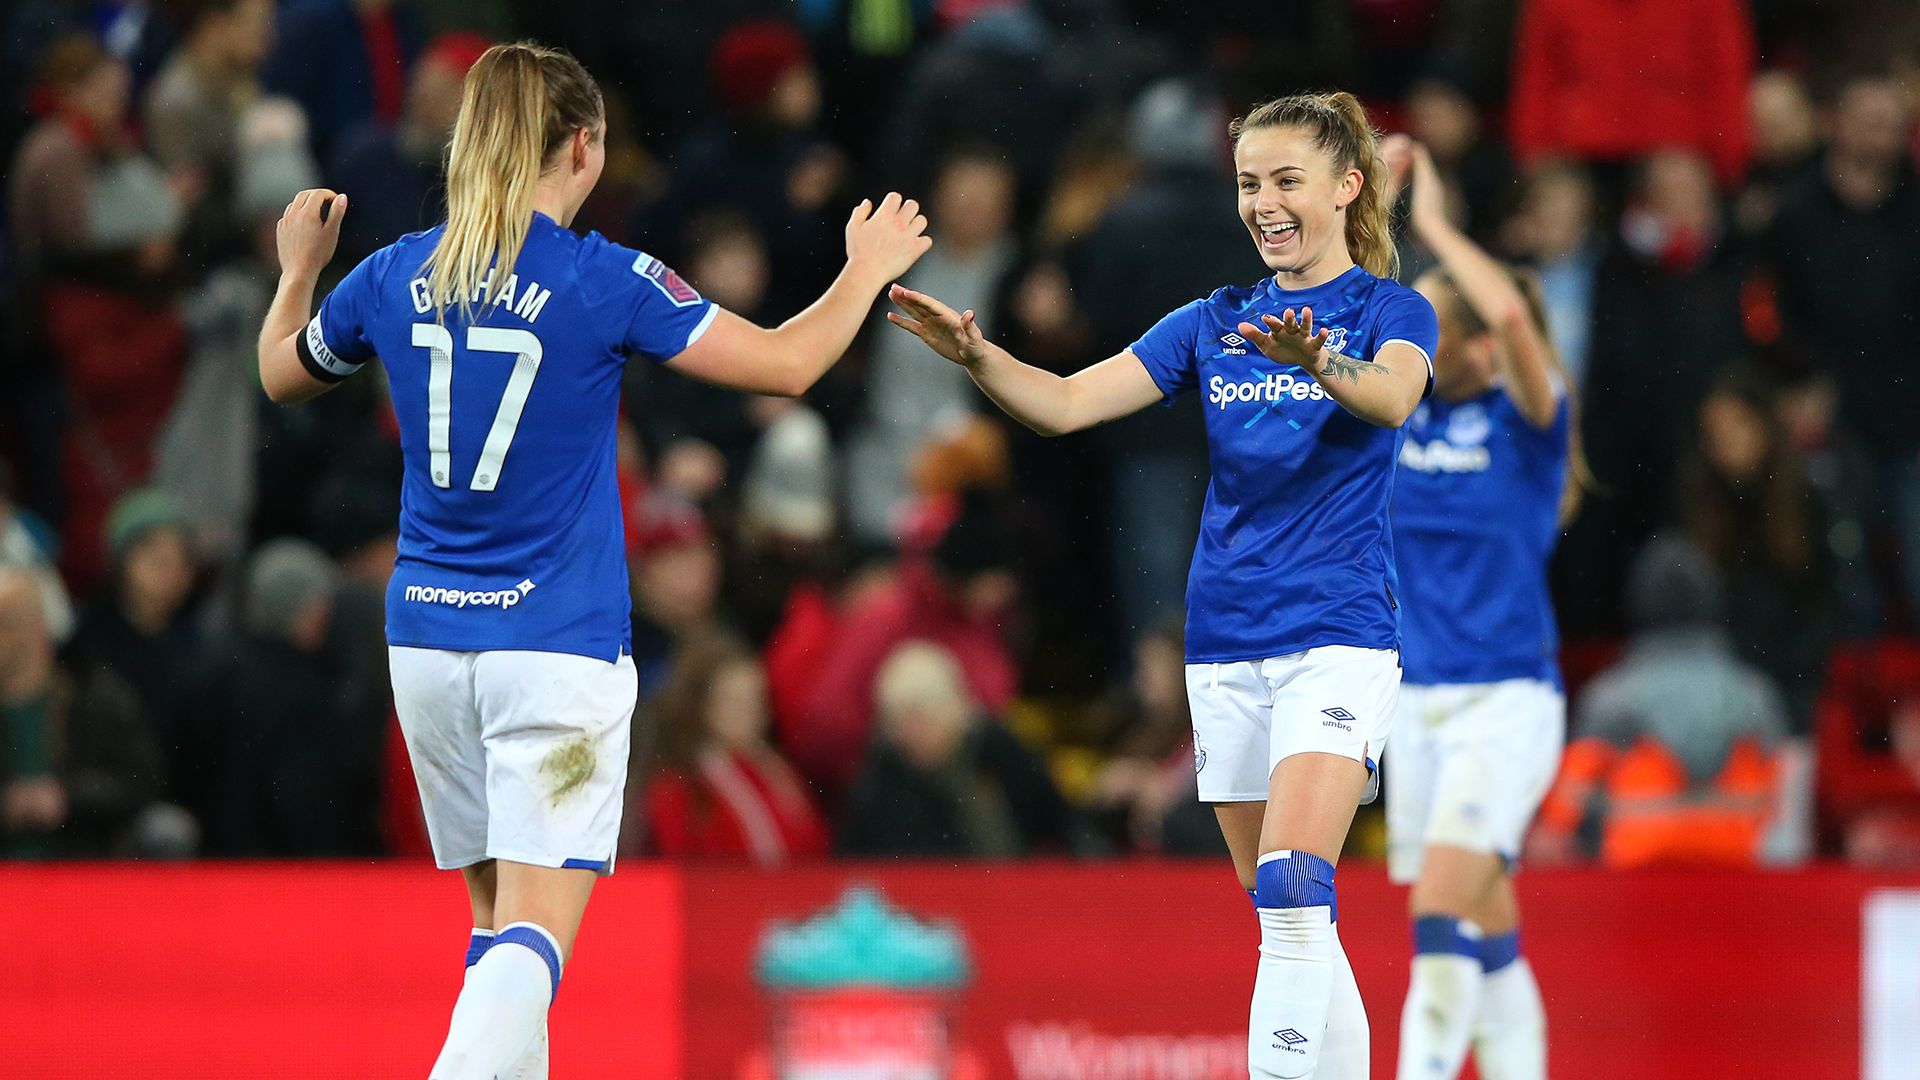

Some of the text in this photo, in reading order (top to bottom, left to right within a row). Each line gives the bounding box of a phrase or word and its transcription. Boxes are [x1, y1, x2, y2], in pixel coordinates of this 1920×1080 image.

[410, 268, 552, 324] GHAM
[310, 324, 336, 368] APTAIN
[1222, 347, 1247, 355] umbro
[411, 322, 543, 491] 17
[405, 585, 520, 610] moneycorp
[1322, 720, 1352, 732] umbro
[1271, 1043, 1306, 1055] umbro
